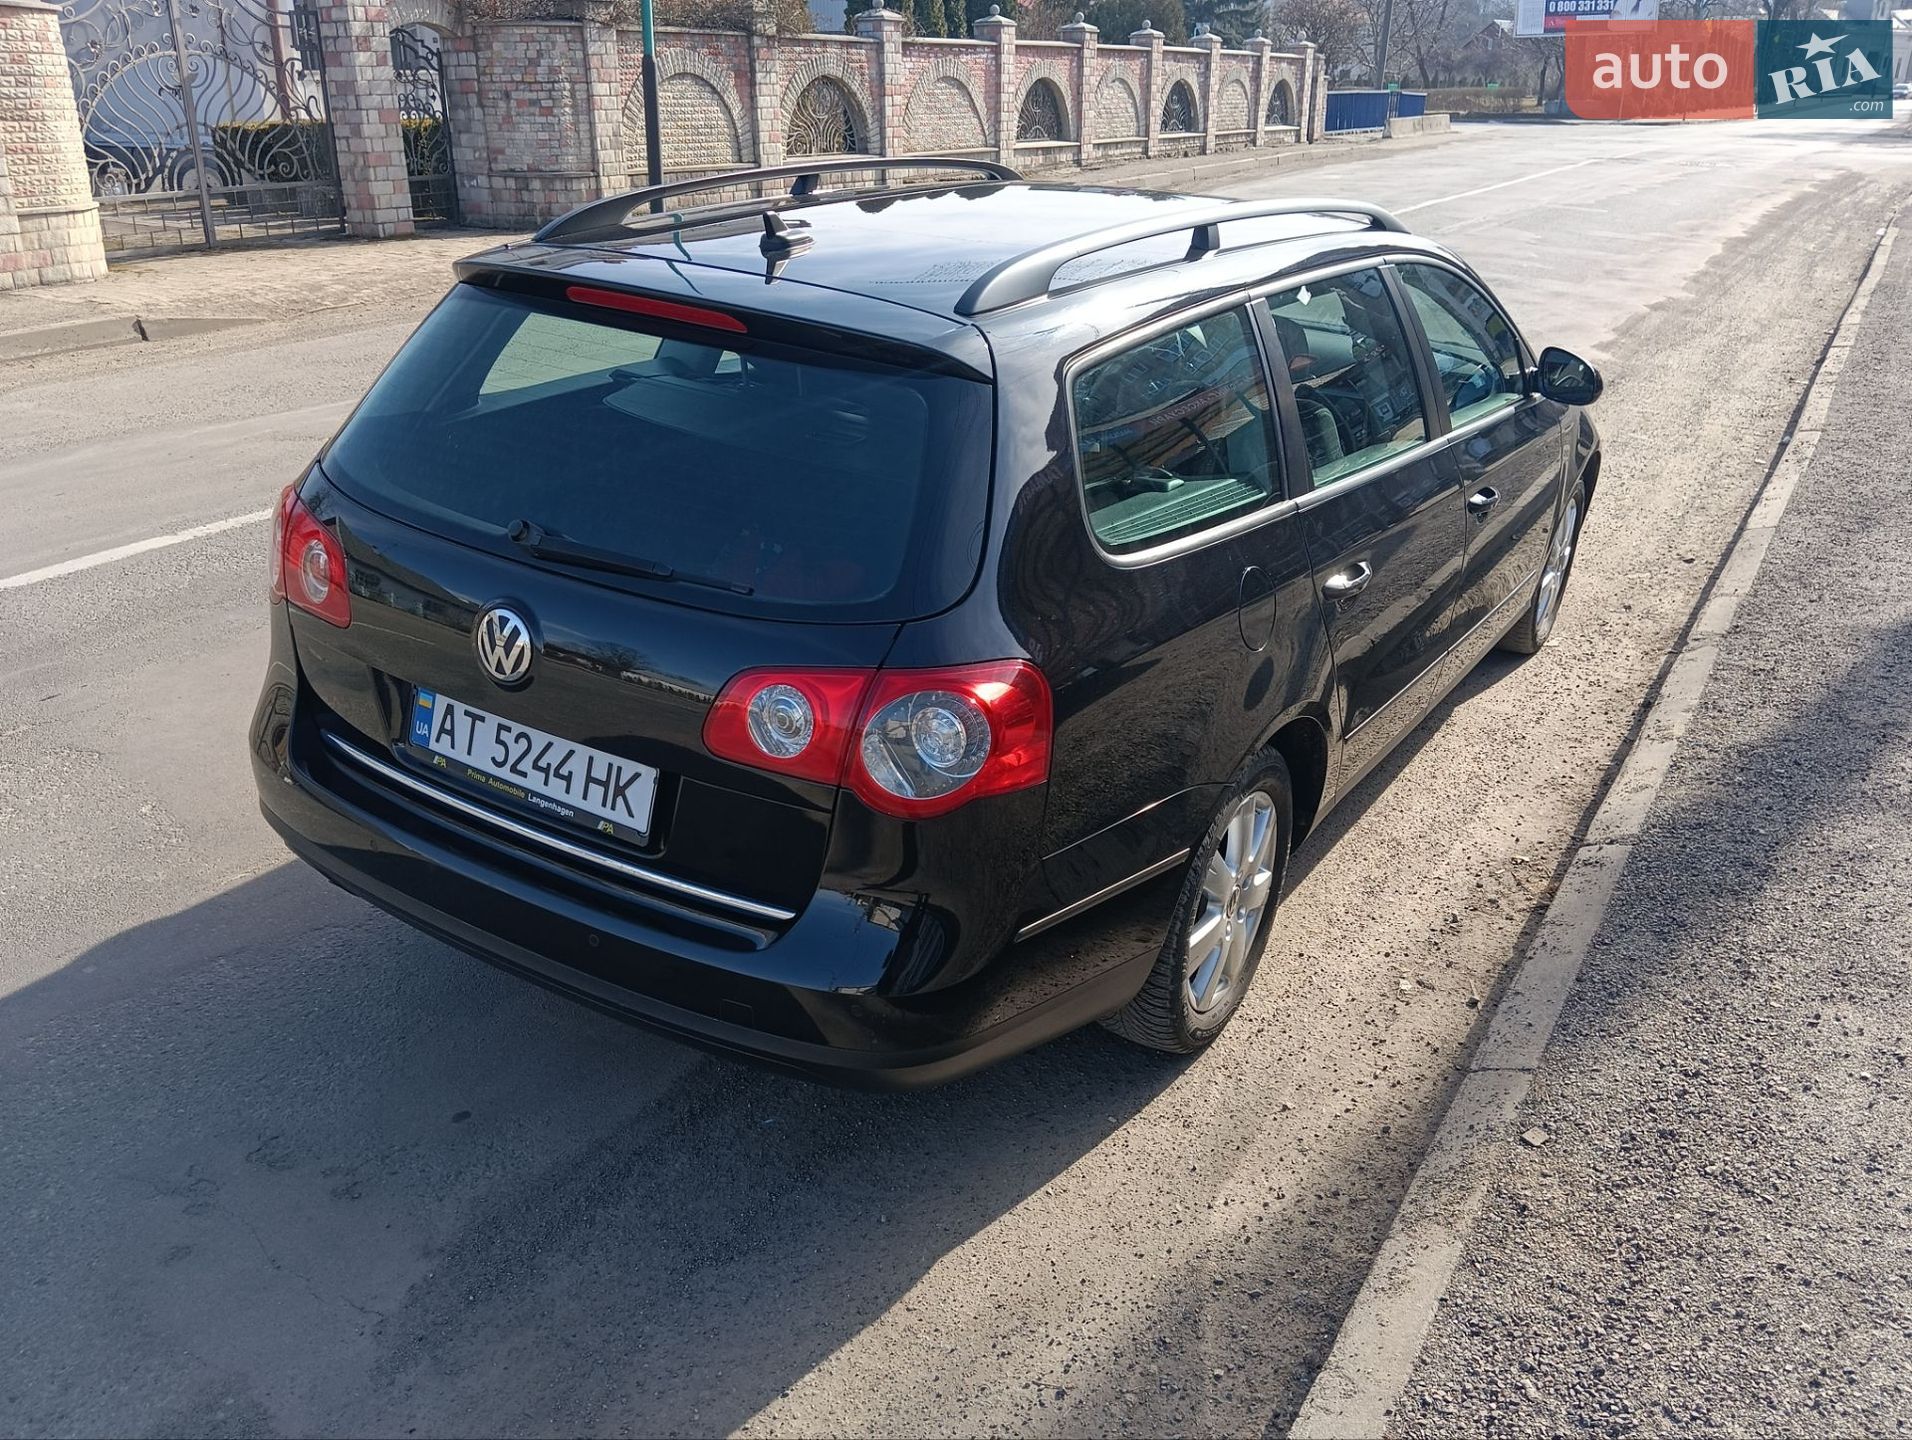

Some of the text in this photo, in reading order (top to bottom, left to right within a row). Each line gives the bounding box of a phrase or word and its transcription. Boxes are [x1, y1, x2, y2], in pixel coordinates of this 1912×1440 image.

[1549, 0, 1614, 12] 0 800 331 331
[478, 608, 532, 680] VW
[416, 721, 429, 737] UA
[435, 703, 642, 818] AT 5244 HK
[467, 768, 525, 798] Prima Automobile
[528, 793, 574, 817] Langenhagen
